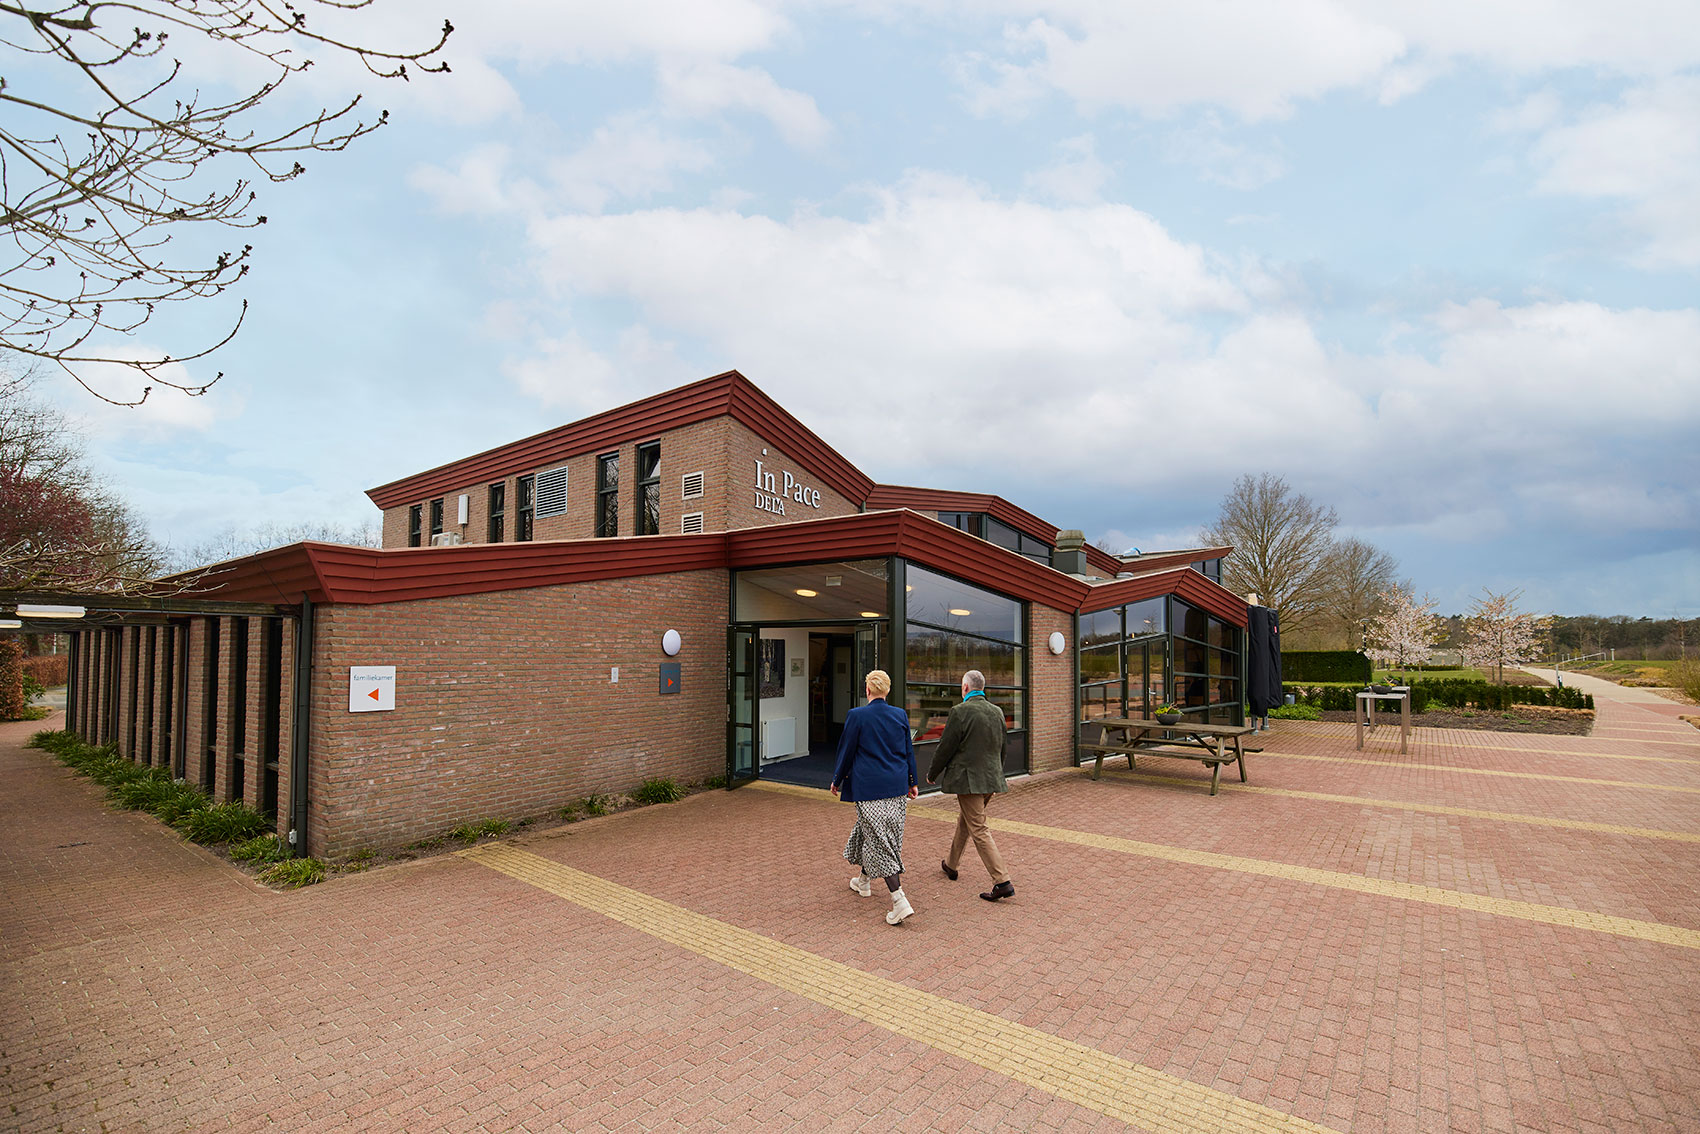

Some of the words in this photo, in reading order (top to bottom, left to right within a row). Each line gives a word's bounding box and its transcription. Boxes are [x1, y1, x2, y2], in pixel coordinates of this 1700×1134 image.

[754, 459, 777, 494] In
[782, 470, 821, 509] Pace
[754, 491, 786, 516] DELA
